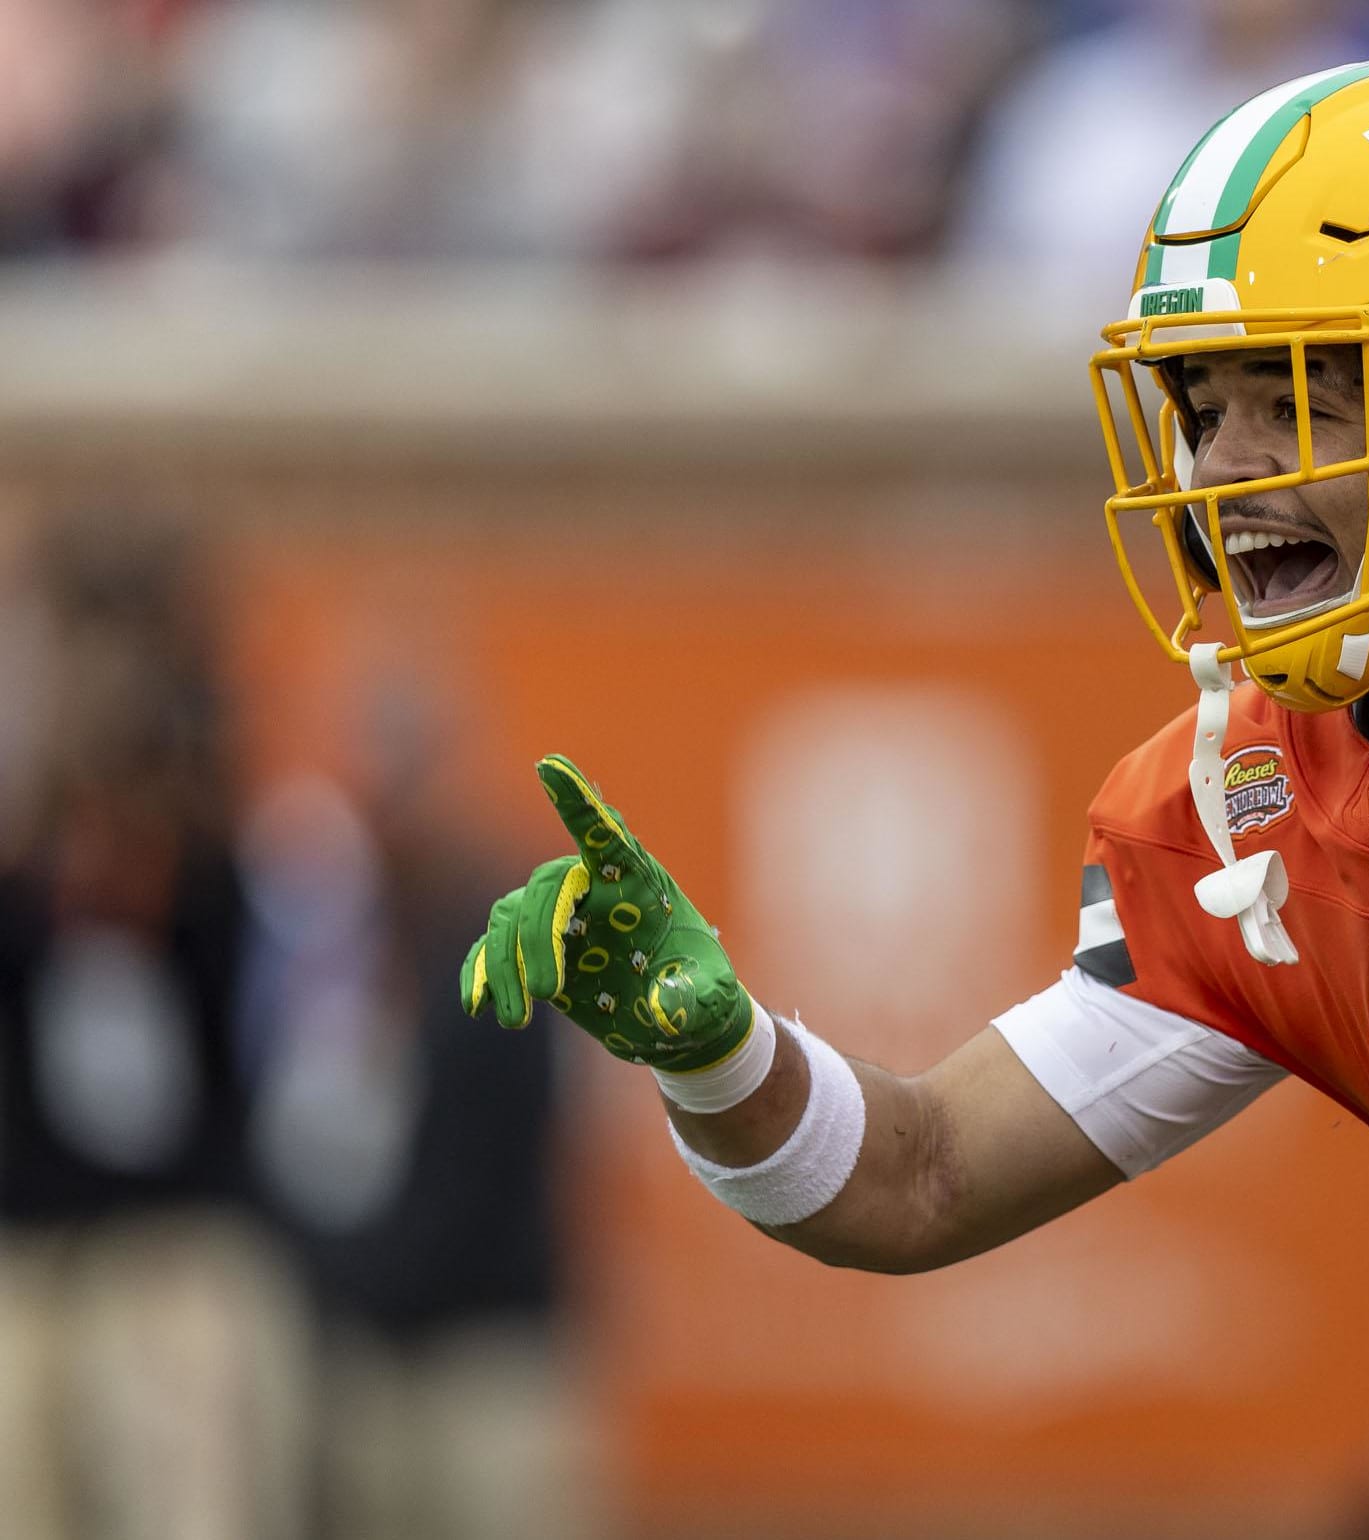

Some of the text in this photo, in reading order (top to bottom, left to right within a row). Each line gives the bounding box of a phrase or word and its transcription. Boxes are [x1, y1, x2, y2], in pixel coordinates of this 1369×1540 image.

[1140, 287, 1204, 318] OREGON
[1224, 759, 1279, 790] Reese's
[1225, 788, 1256, 819] ENIOR
